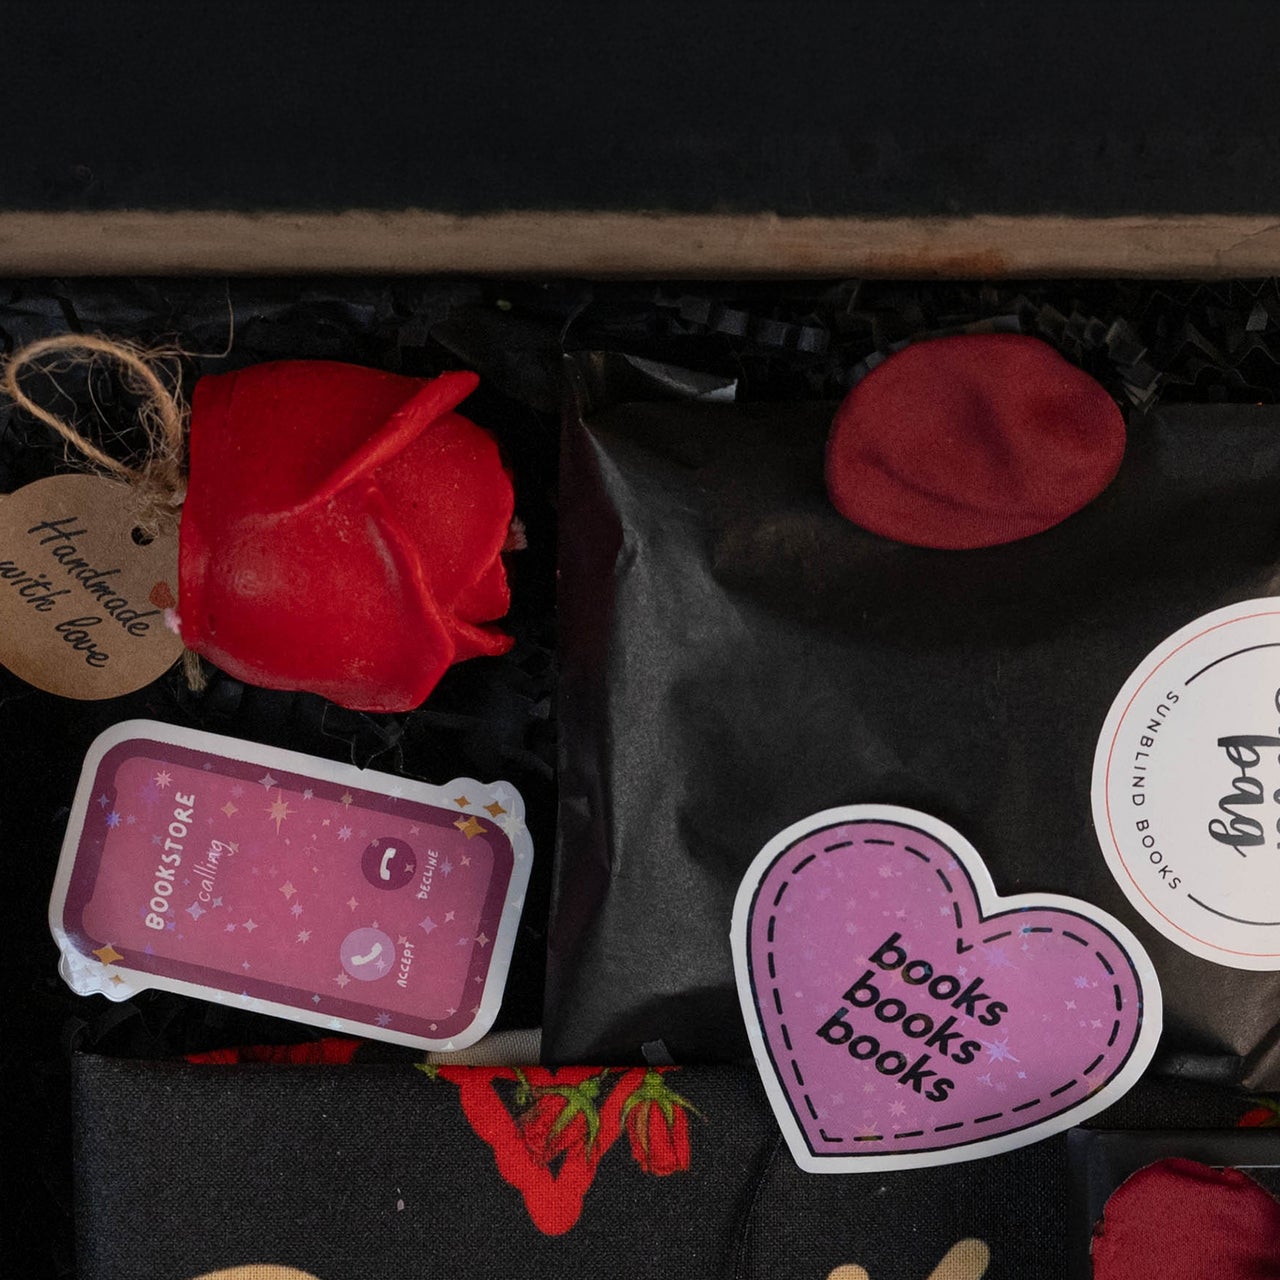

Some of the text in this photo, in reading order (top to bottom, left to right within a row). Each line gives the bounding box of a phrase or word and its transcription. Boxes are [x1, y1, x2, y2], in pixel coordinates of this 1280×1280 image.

[27, 516, 151, 638] Handmade
[56, 615, 110, 669] love
[1131, 690, 1182, 890] SUNBLIND BOOKS
[146, 791, 196, 930] BOOKSTORE
[197, 838, 235, 904] calling
[419, 847, 440, 900] DECLINE
[397, 940, 416, 988] ACCEPT
[868, 932, 1009, 1026] books
[815, 1007, 955, 1103] books
[842, 970, 981, 1065] books
